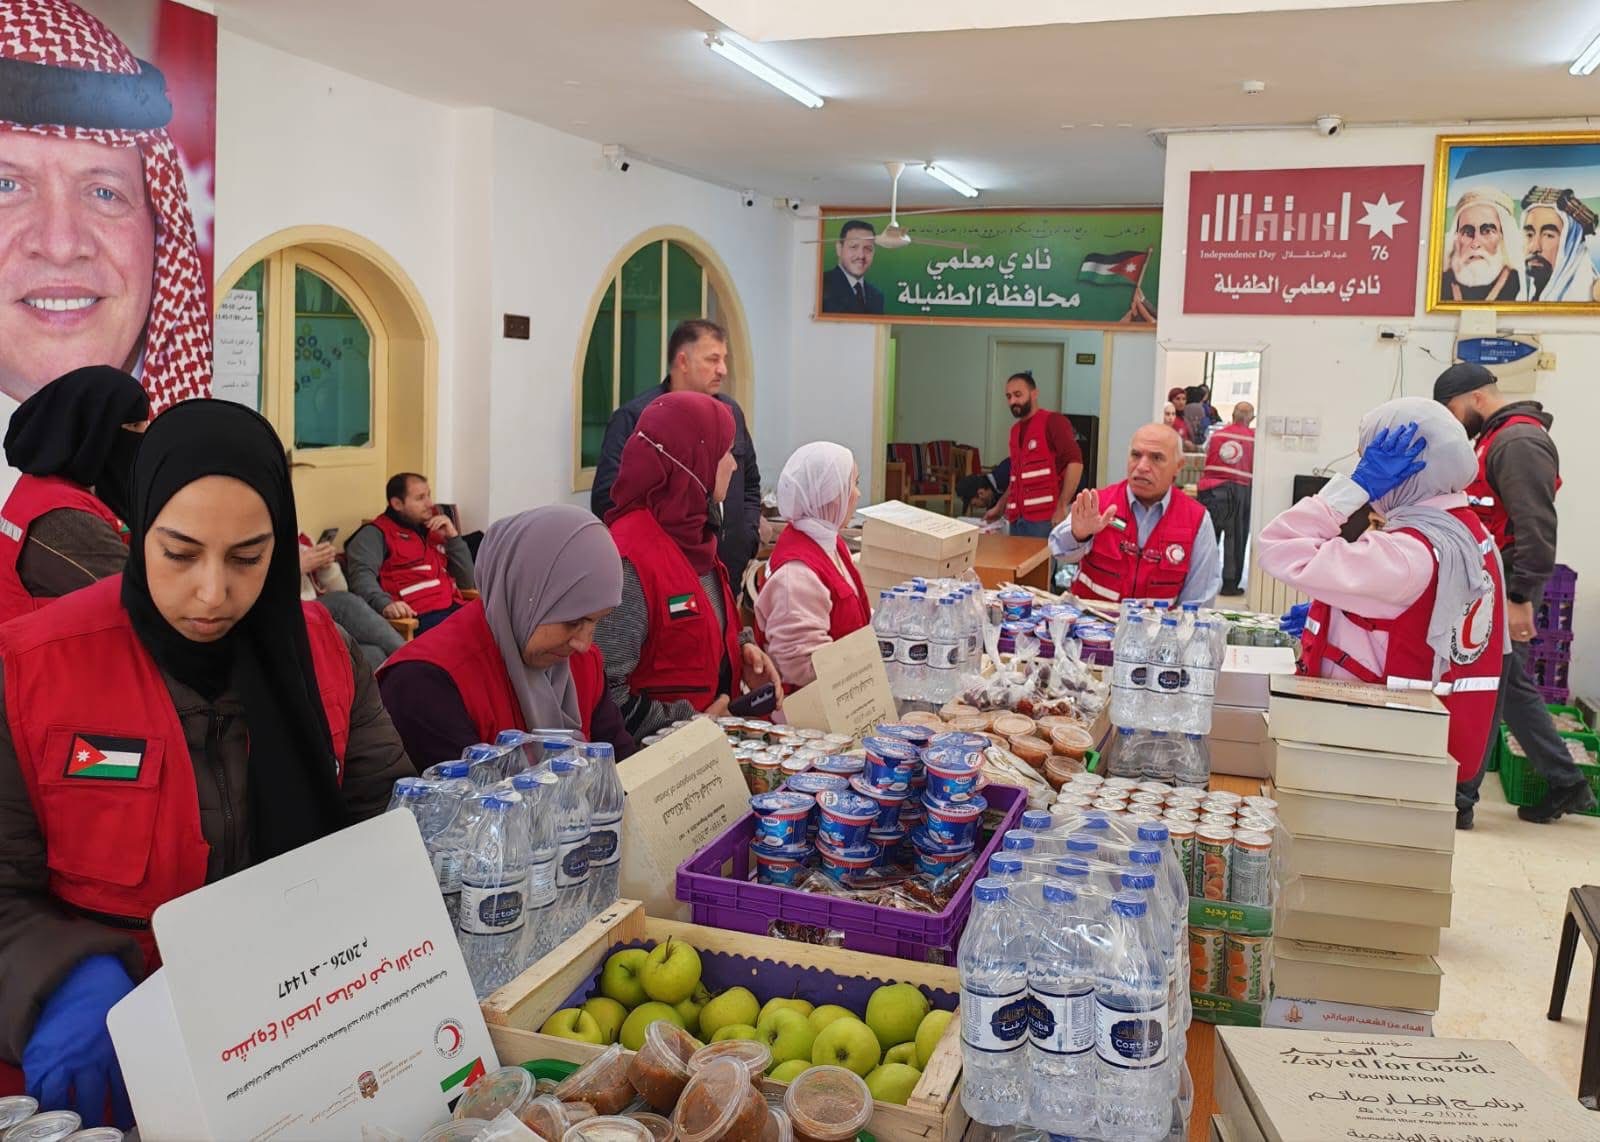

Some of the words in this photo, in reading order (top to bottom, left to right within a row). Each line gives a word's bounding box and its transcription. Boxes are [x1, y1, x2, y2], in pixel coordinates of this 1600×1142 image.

[926, 248, 995, 279] معلمي
[999, 248, 1052, 279] نادي
[1200, 250, 1256, 260] Independence
[1258, 250, 1276, 260] Day
[1371, 245, 1389, 261] 76
[897, 281, 982, 312] الطفيلة
[986, 282, 1081, 308] محافظة
[1213, 272, 1280, 299] الطفيلة
[1282, 274, 1336, 303] معلمي
[1339, 274, 1381, 302] نادي
[278, 968, 307, 999] 1447
[330, 942, 362, 969] 2026
[221, 1021, 278, 1062] مشروع
[326, 971, 367, 1006] صائم
[370, 957, 393, 984] في
[395, 940, 434, 973] الأردن
[1115, 1039, 1159, 1049] Cortba
[1373, 1059, 1411, 1070] for
[1348, 1072, 1446, 1084] FOUNDATION
[1308, 1090, 1380, 1102] صائم
[1385, 1092, 1451, 1110] إفطار
[1449, 1096, 1528, 1112] برنامج
